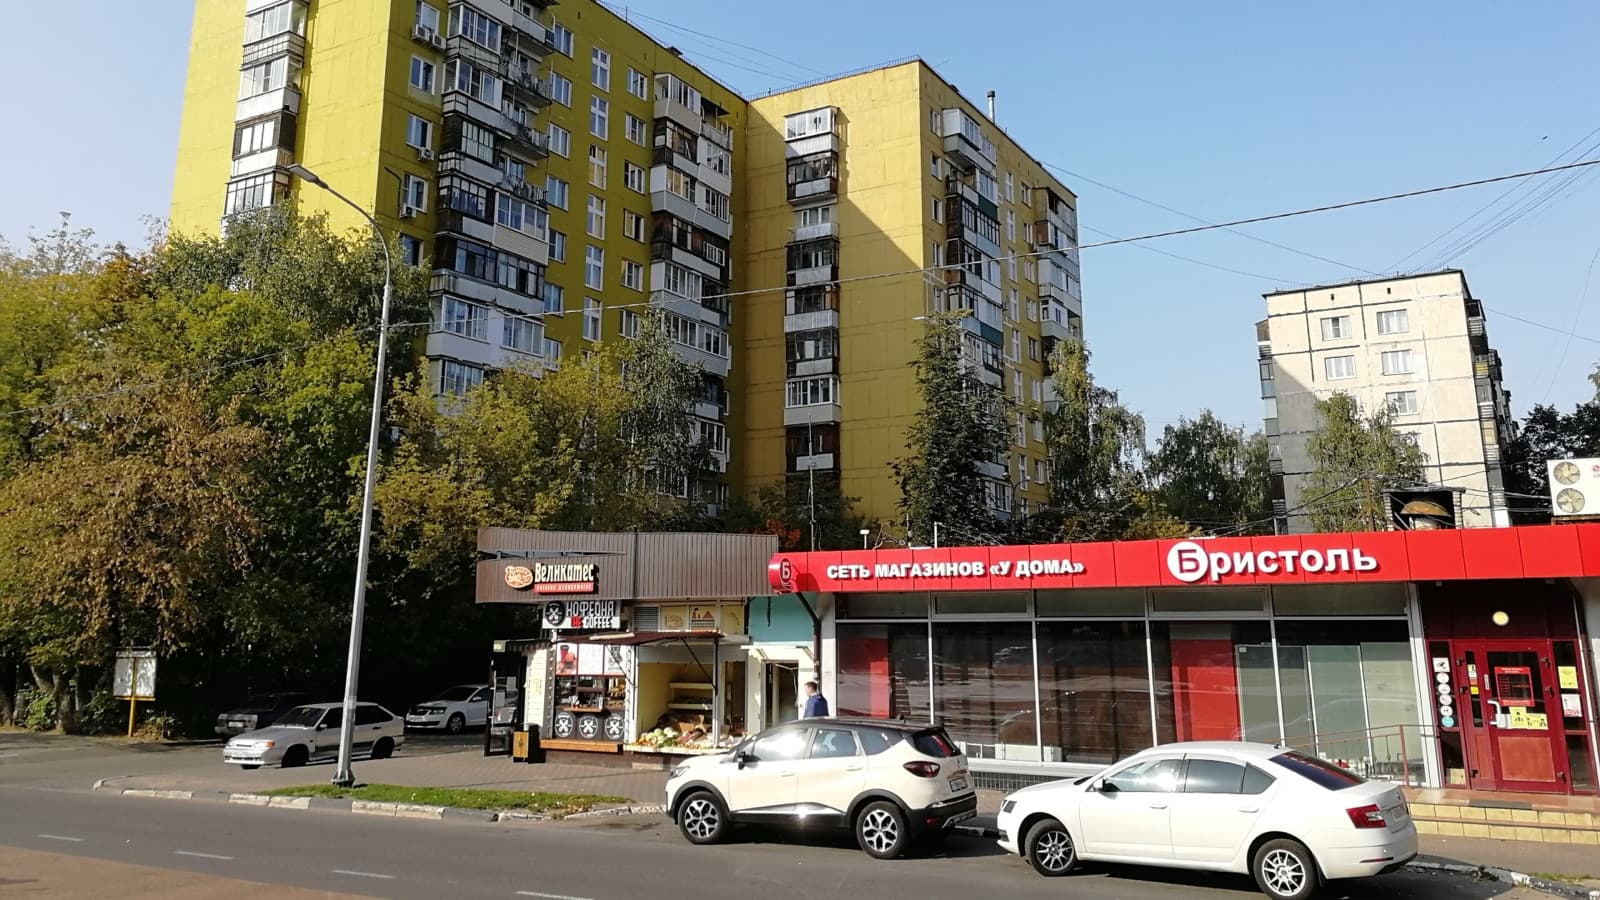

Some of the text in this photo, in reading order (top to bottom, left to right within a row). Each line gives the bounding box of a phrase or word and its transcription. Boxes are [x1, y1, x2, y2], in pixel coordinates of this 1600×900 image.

[534, 562, 594, 583] Великатес
[826, 559, 1084, 579] СЕТЬ МАГАЗИНОВ «У ДОМА»
[1172, 546, 1378, 582] Бристоль
